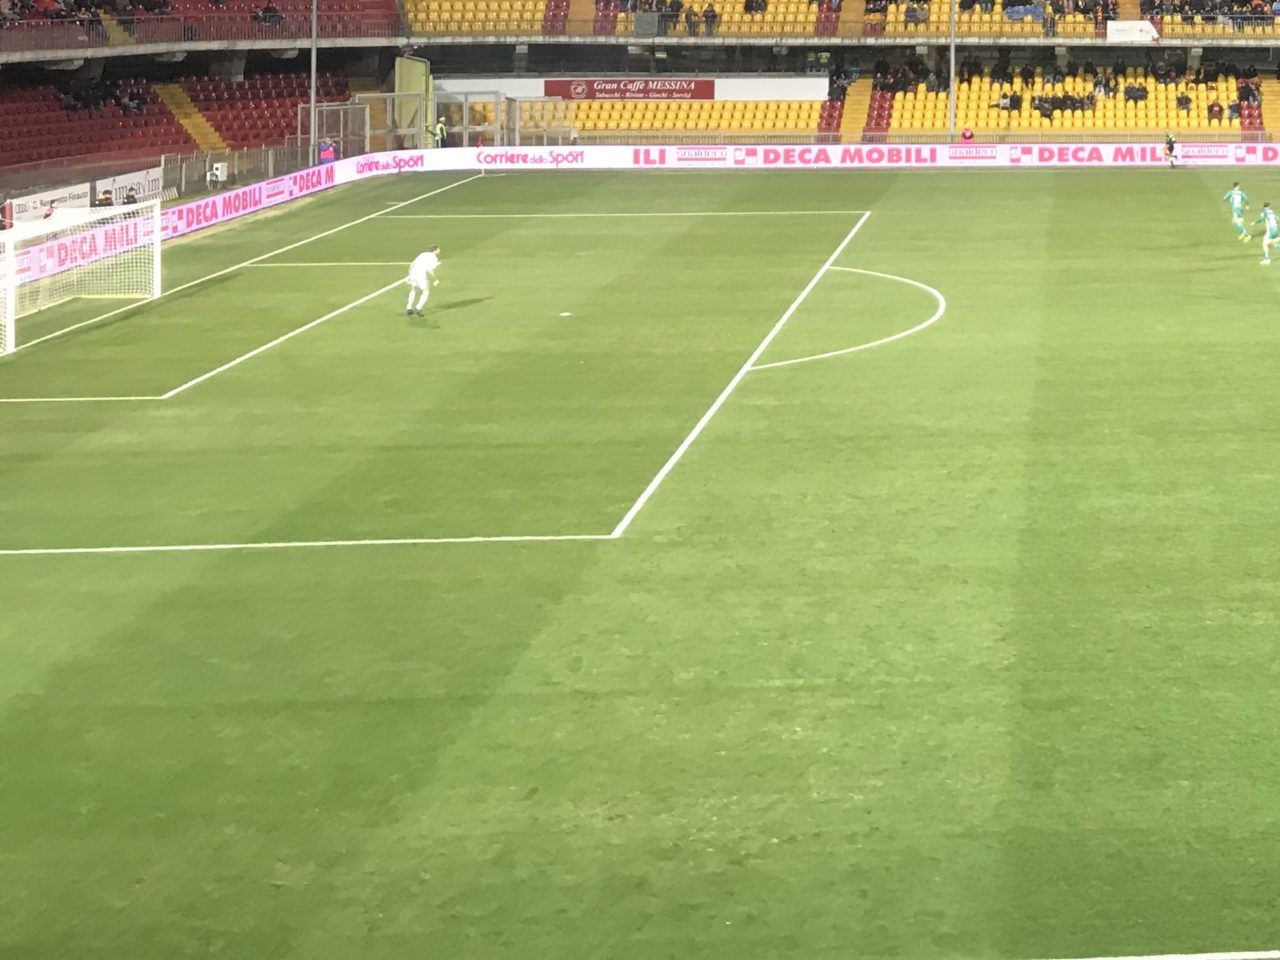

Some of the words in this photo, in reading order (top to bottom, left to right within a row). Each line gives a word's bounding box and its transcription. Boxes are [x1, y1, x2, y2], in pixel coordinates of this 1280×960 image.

[594, 81, 617, 89] Gran
[647, 81, 695, 89] MESSINA
[476, 151, 529, 164] Corriere
[549, 150, 584, 166] Sport
[763, 148, 832, 165] DECA
[840, 147, 937, 163] MOBILI
[1038, 146, 1104, 162] DECA
[393, 155, 424, 171] Sport
[298, 171, 322, 193] DECA
[186, 200, 218, 228] DECA
[222, 186, 262, 217] MOBILI
